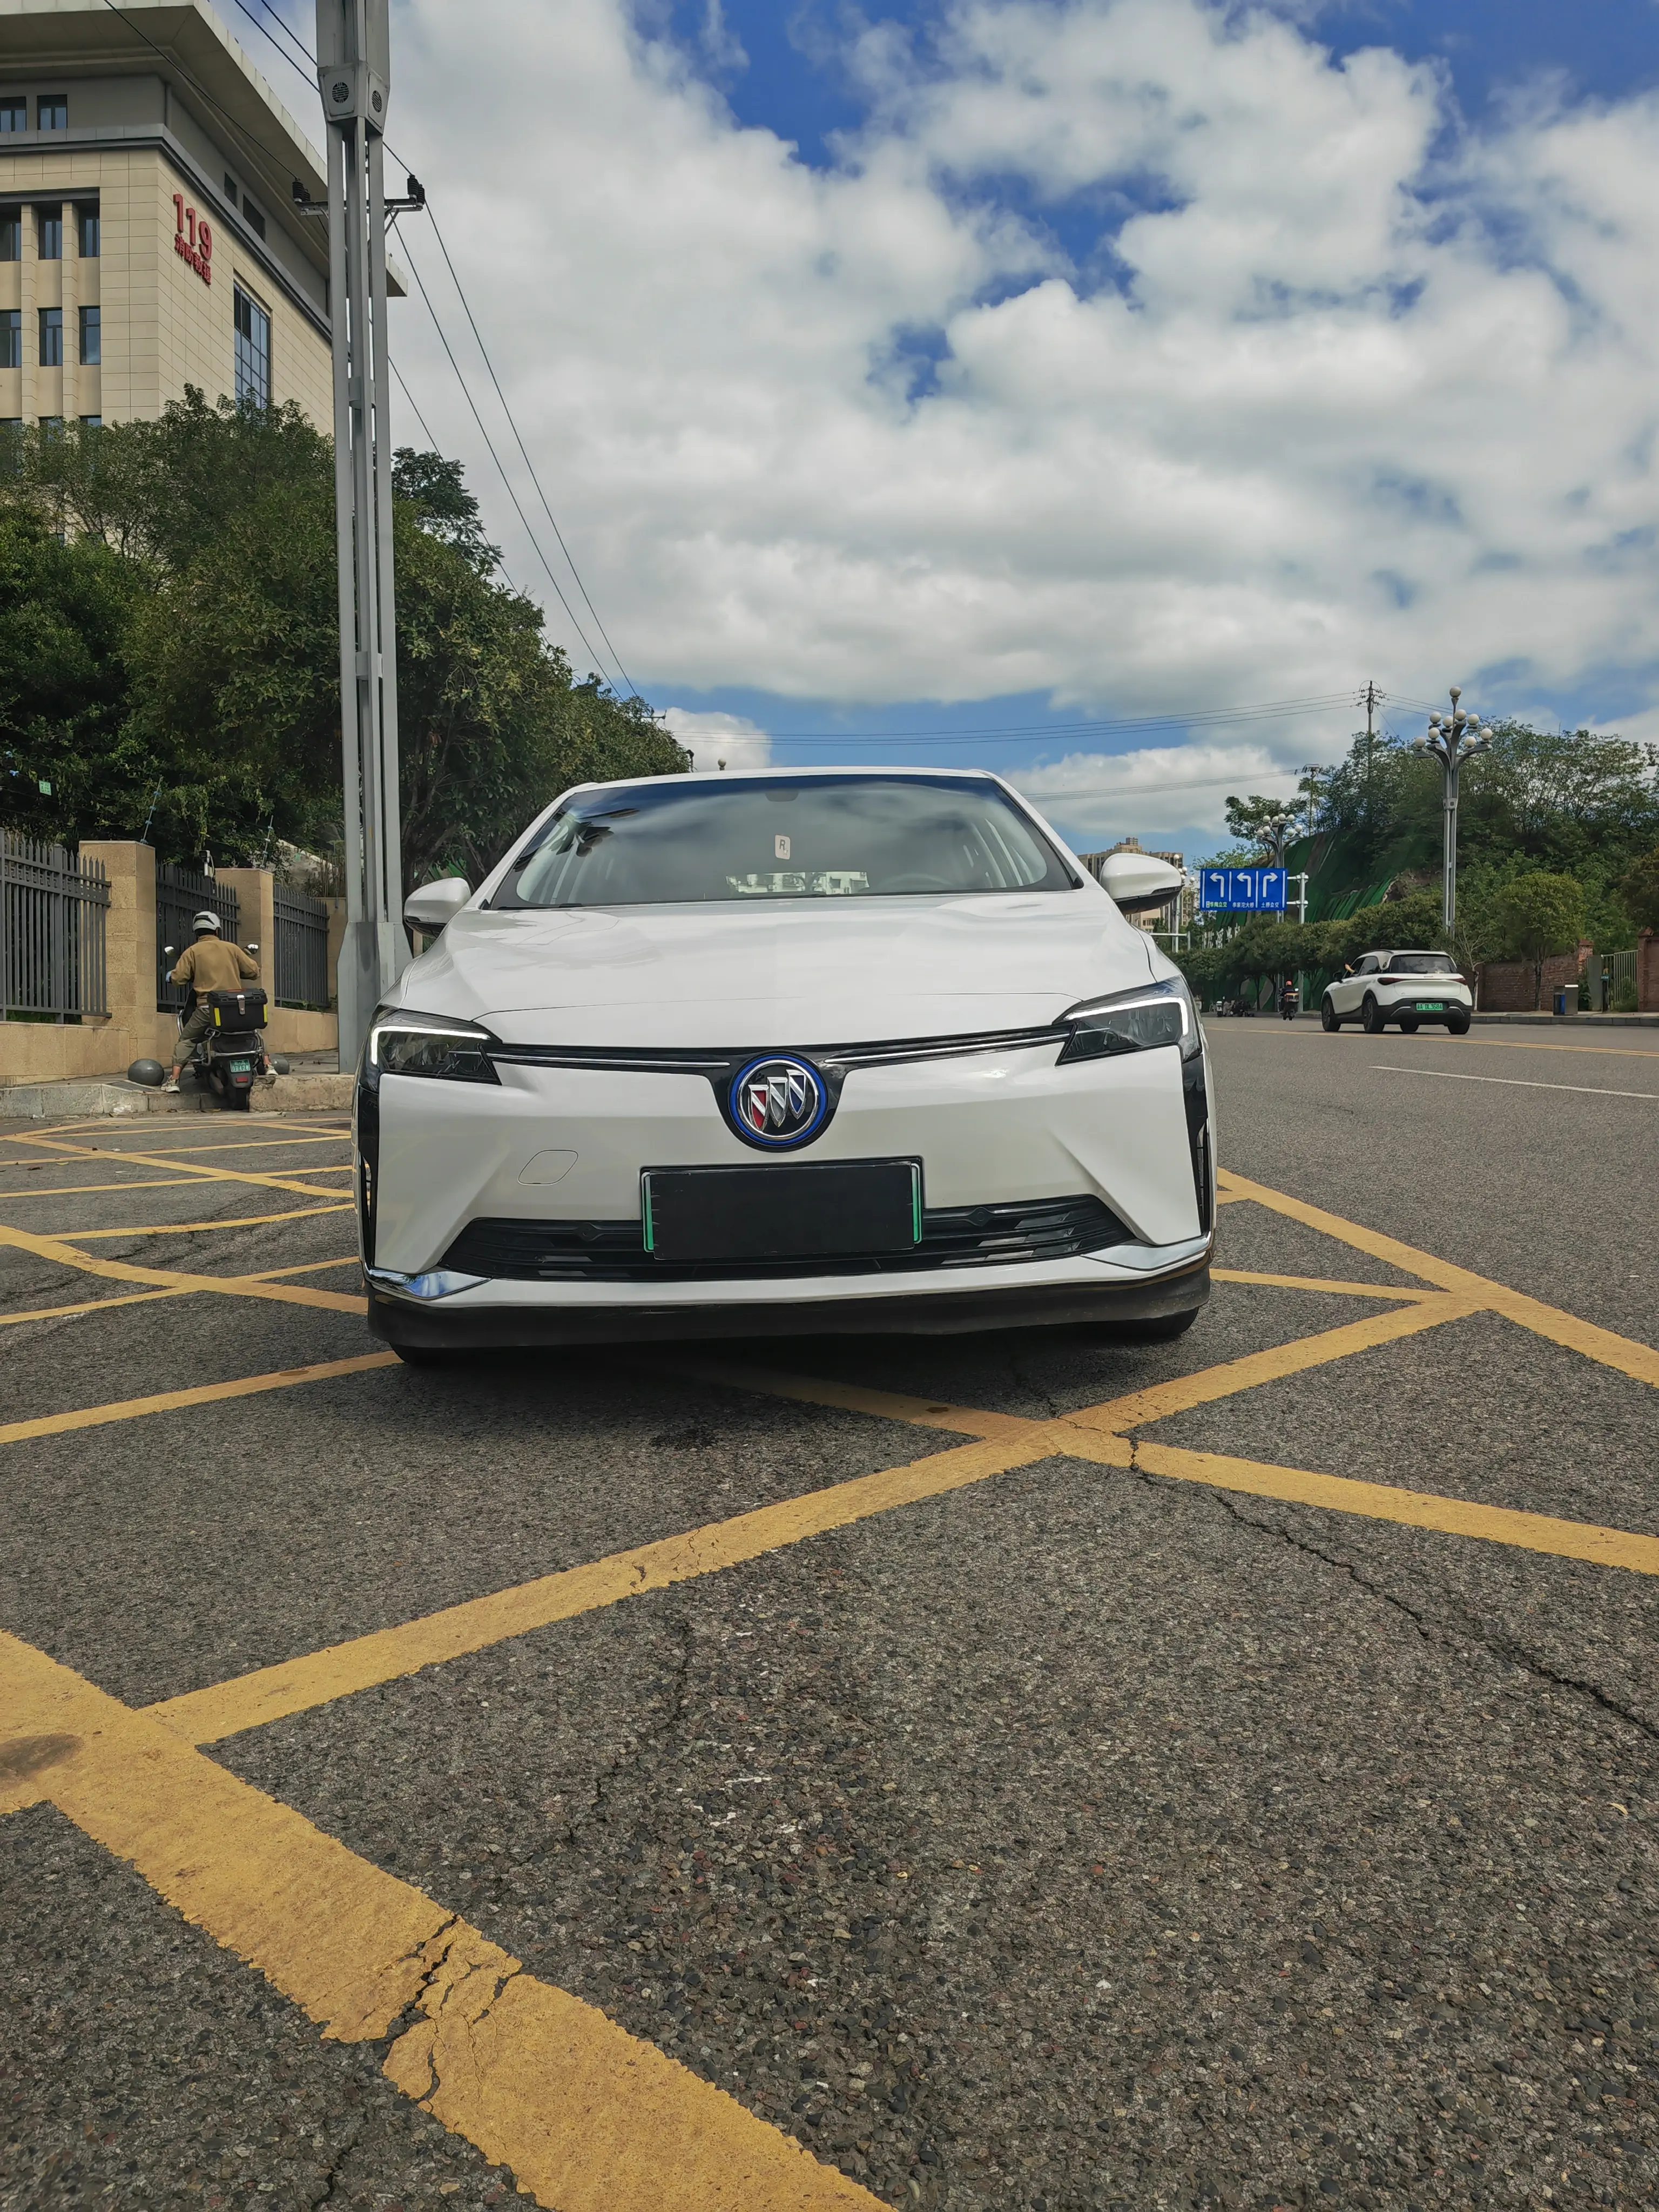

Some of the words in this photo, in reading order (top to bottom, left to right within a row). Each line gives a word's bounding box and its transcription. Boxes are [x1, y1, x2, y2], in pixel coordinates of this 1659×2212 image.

[173, 193, 212, 260] 119
[174, 233, 212, 285] 消防救援
